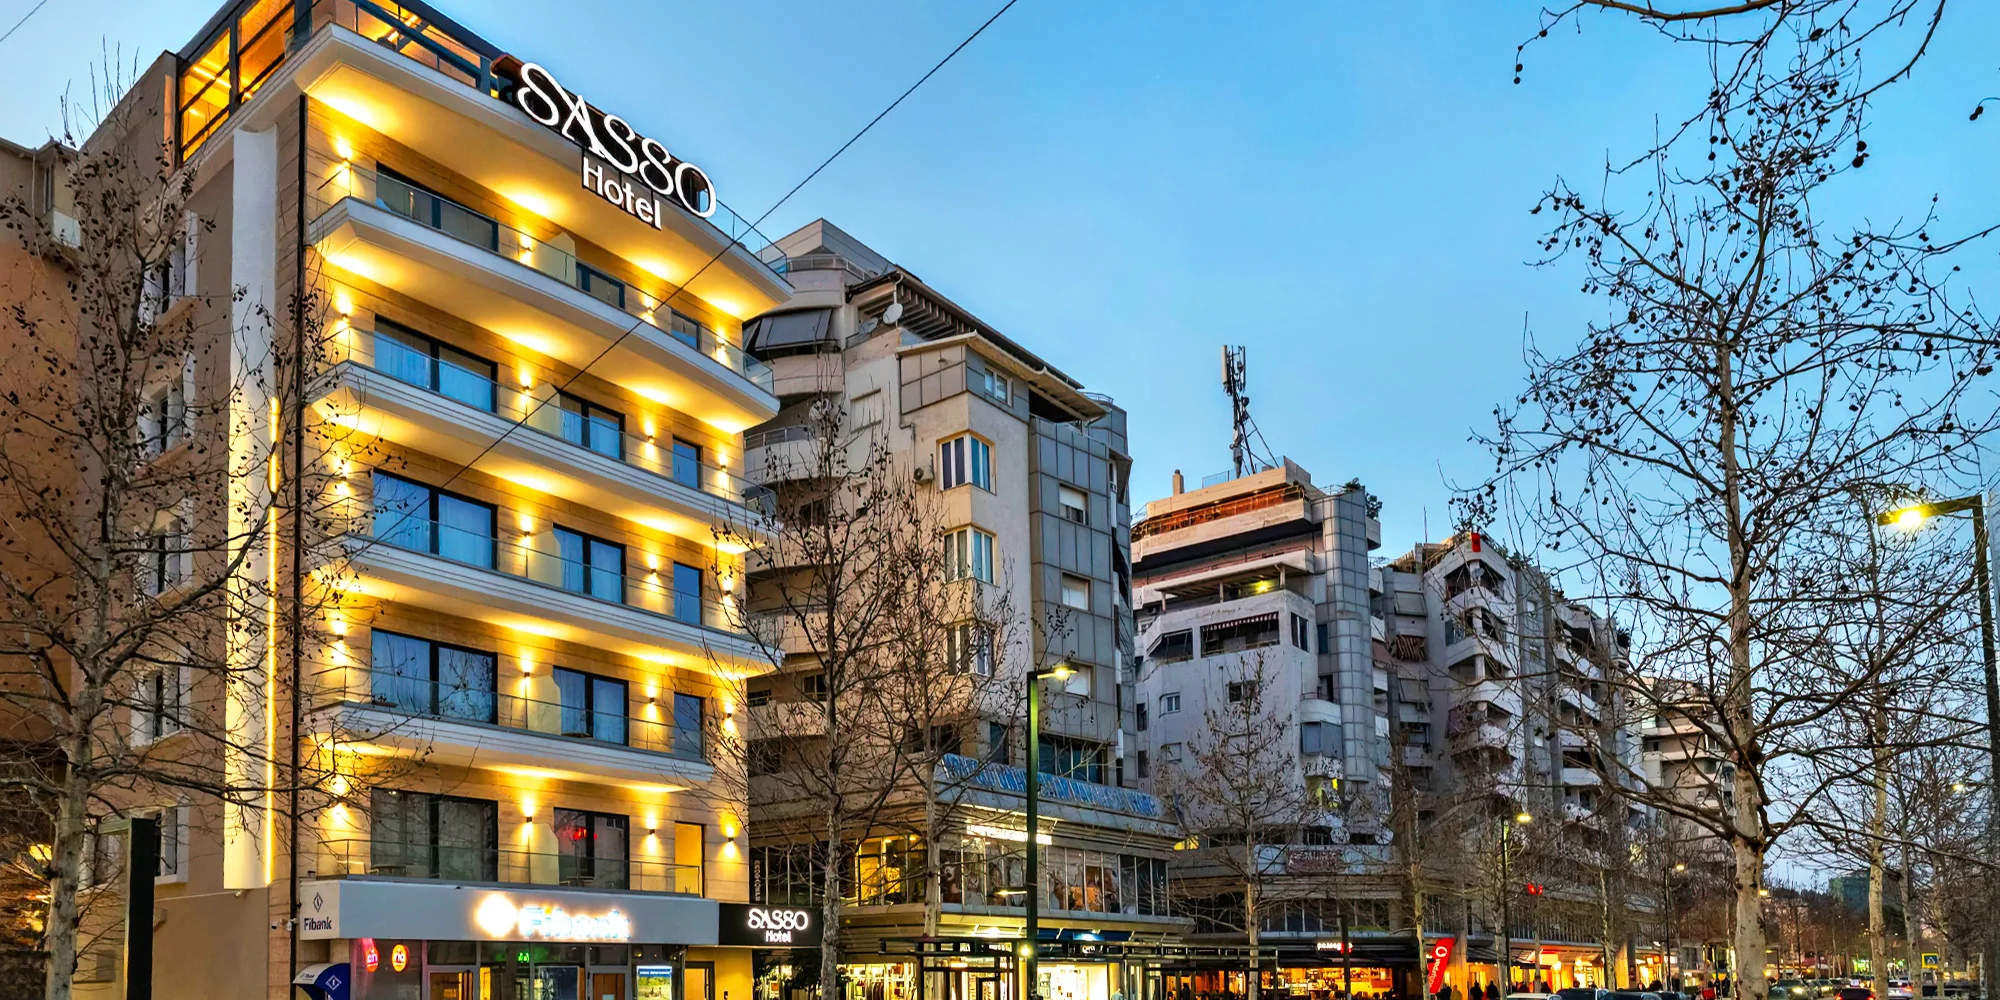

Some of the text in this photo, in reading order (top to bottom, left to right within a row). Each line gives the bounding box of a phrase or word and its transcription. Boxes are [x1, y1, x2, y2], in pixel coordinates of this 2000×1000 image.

[517, 62, 717, 218] SASSO
[582, 157, 662, 230] Hotel
[303, 916, 332, 931] Fibank
[521, 906, 632, 939] Fibank
[748, 908, 809, 931] SASSO
[765, 930, 792, 943] Hotel
